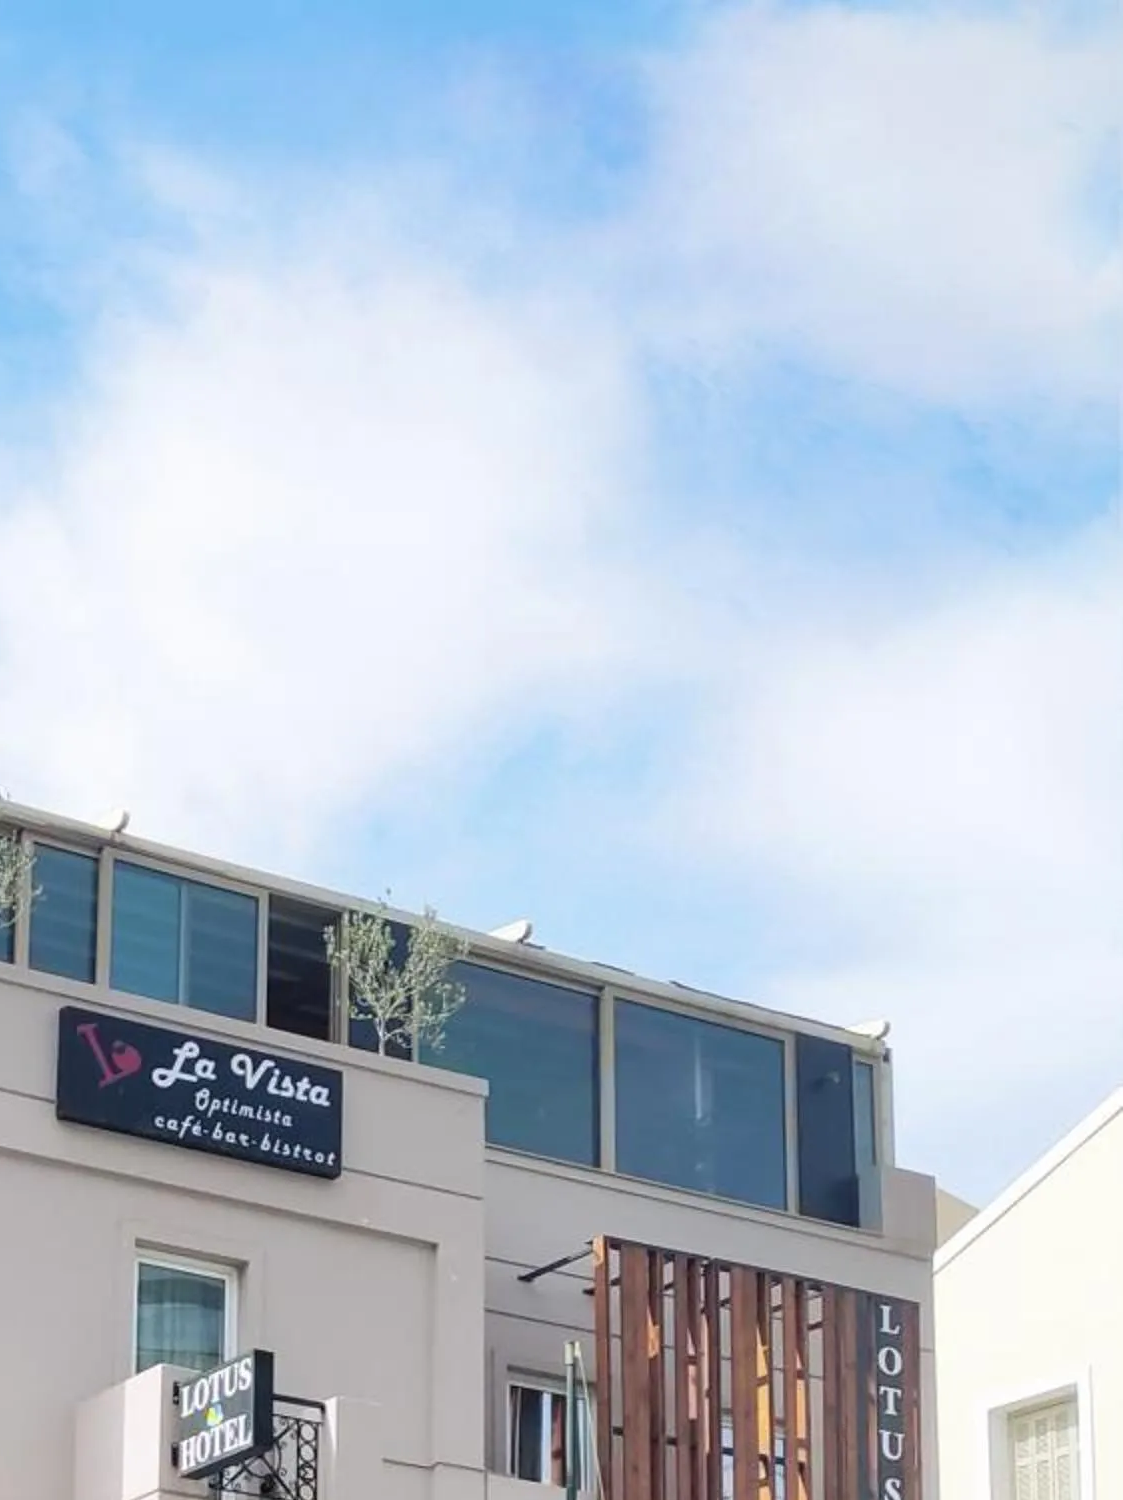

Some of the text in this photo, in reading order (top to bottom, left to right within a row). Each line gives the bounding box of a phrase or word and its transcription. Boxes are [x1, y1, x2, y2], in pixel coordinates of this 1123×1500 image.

[152, 1041, 331, 1107] La Vista
[194, 1087, 293, 1128] Optimista
[180, 1357, 252, 1418] LOTUS
[179, 1414, 252, 1472] HOTEL
